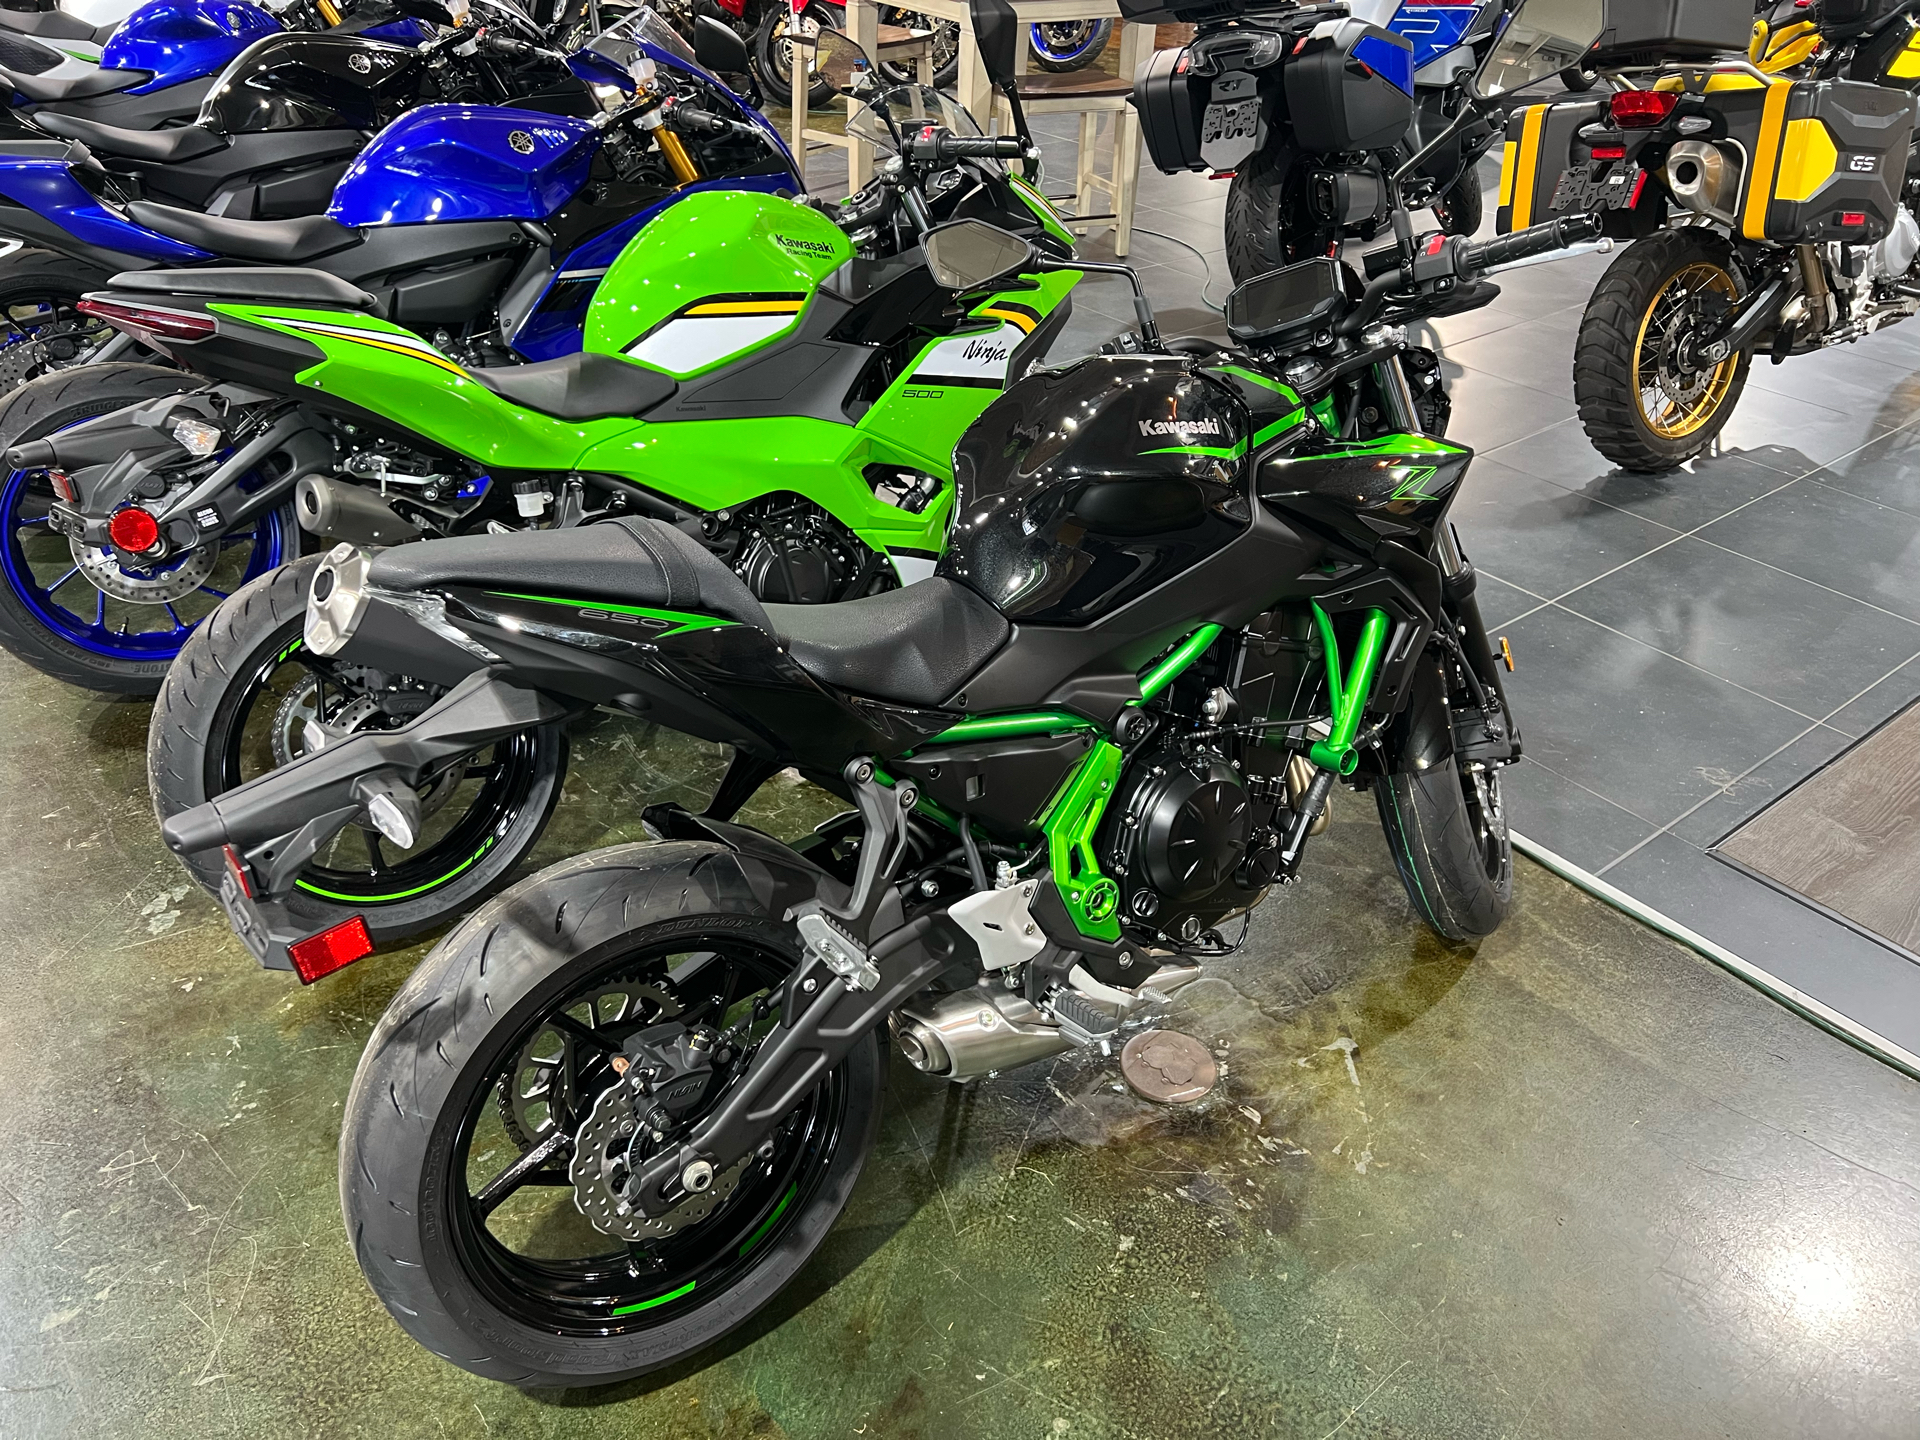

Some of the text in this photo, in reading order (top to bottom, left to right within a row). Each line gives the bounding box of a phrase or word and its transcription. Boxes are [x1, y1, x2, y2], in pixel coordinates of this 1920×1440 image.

[1850, 155, 1876, 171] GS
[775, 233, 835, 254] Kawasaki
[786, 247, 832, 260] Racing Team
[962, 339, 1009, 367] Ninja
[902, 389, 944, 399] 500
[1138, 417, 1220, 437] Kawasaki
[578, 608, 670, 629] 650
